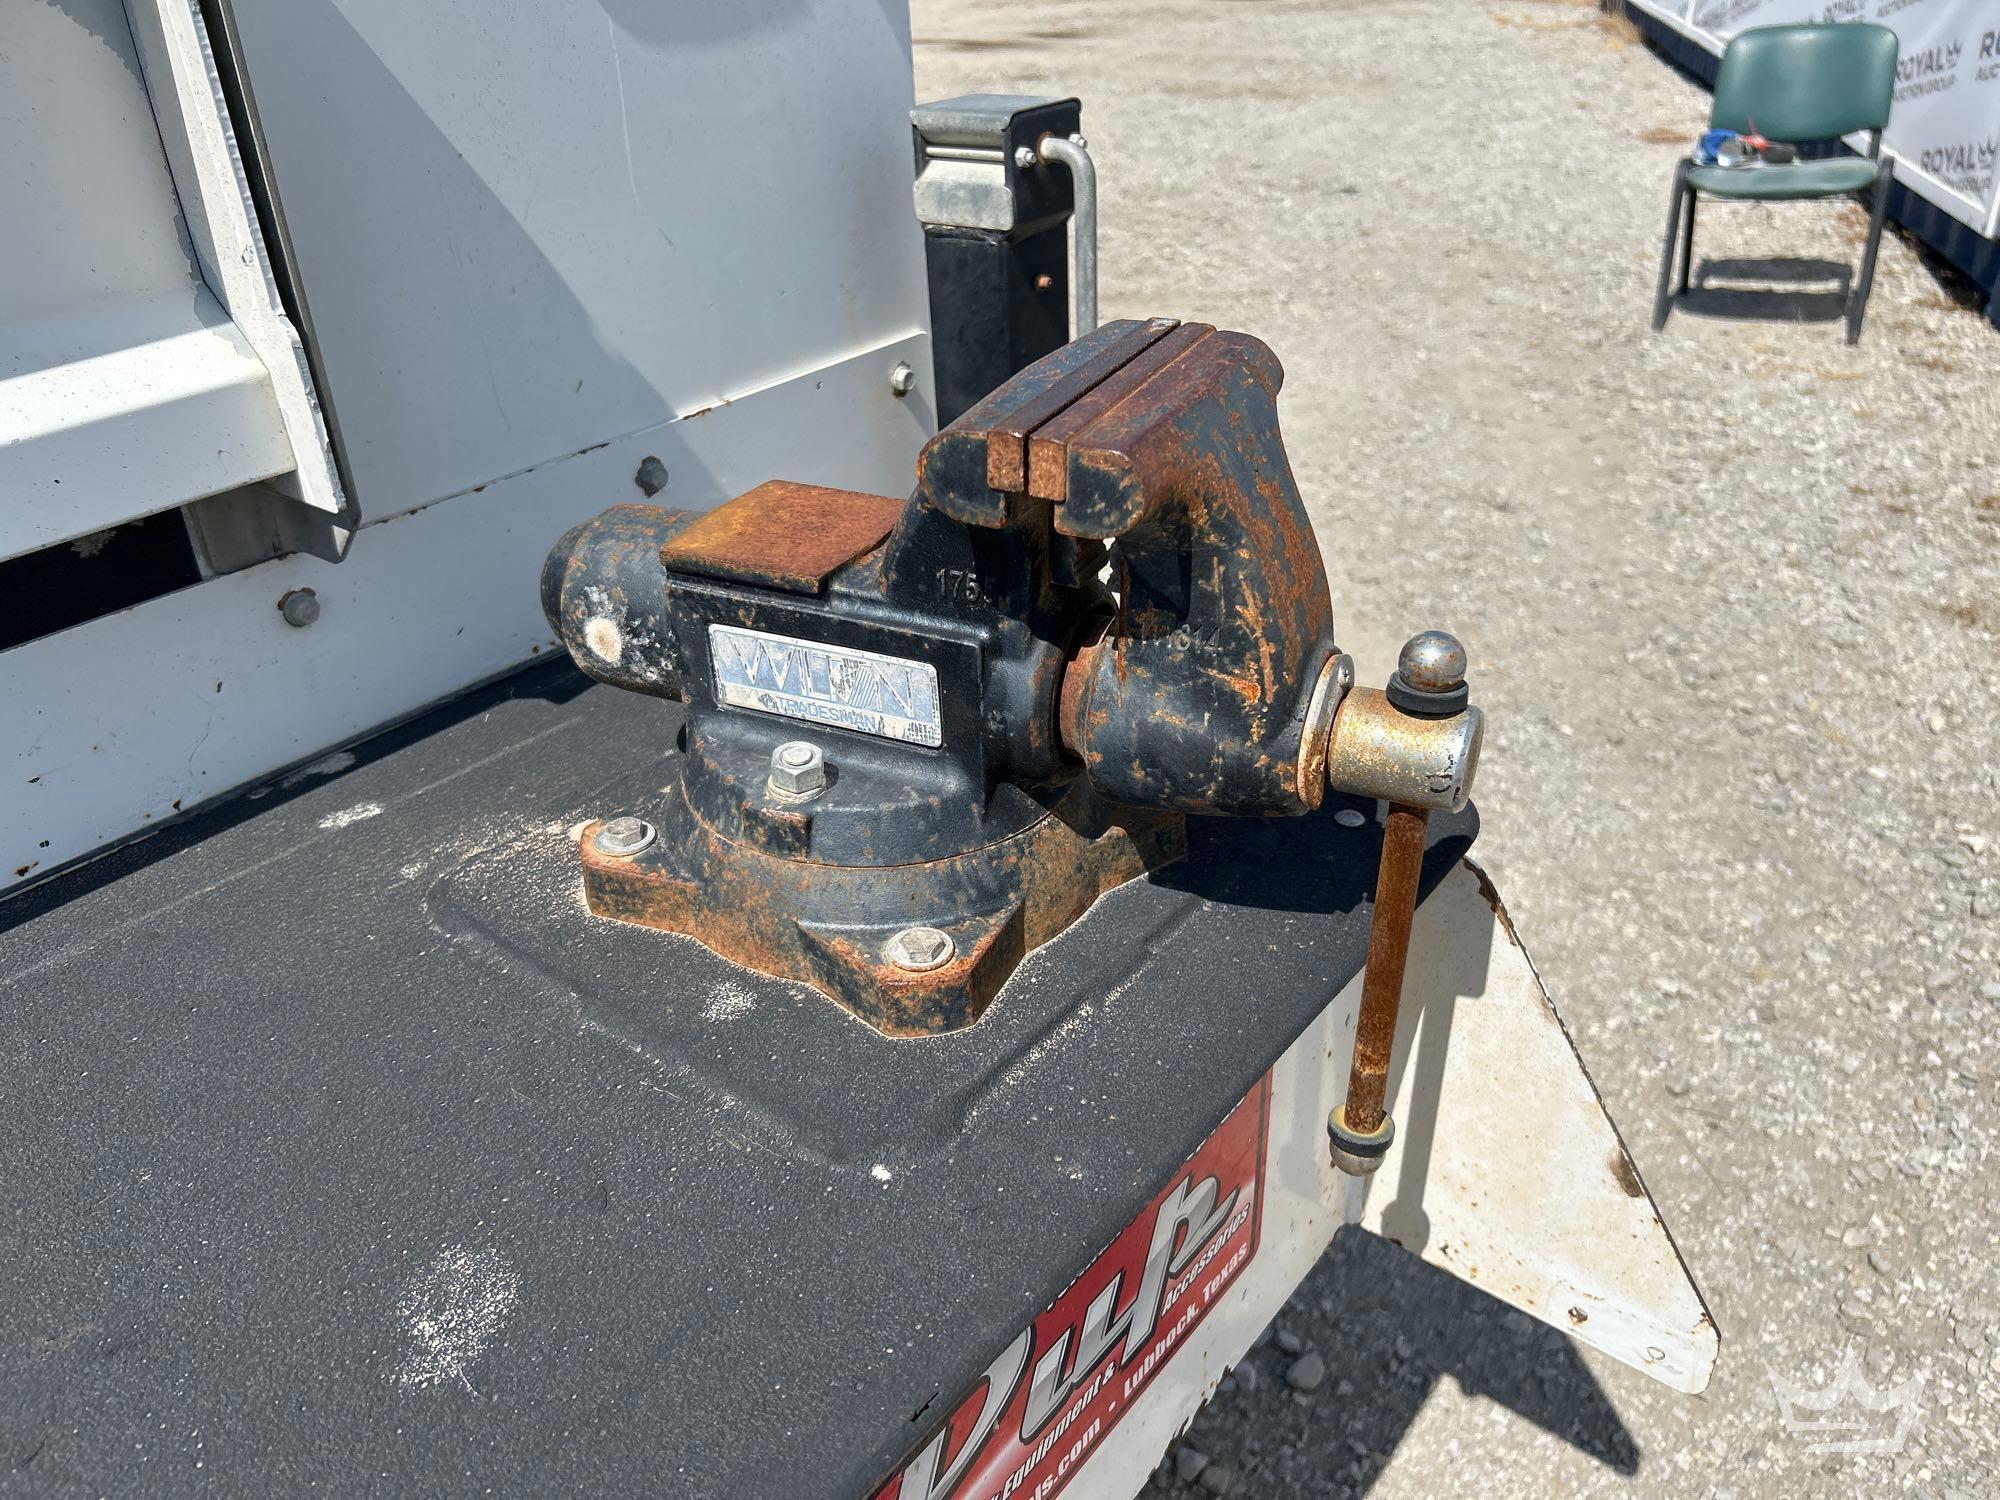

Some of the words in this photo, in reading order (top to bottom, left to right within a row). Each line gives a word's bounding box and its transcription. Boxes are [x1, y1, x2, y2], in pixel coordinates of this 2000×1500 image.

[1920, 144, 1975, 172] ROYAL
[774, 695, 878, 733] TRADESMAN
[1001, 1373, 1102, 1500] Equipment
[1102, 1360, 1116, 1386] &
[1160, 1202, 1250, 1318] Accessories
[1030, 1417, 1101, 1500] ls.com
[1202, 1242, 1247, 1303] Texas
